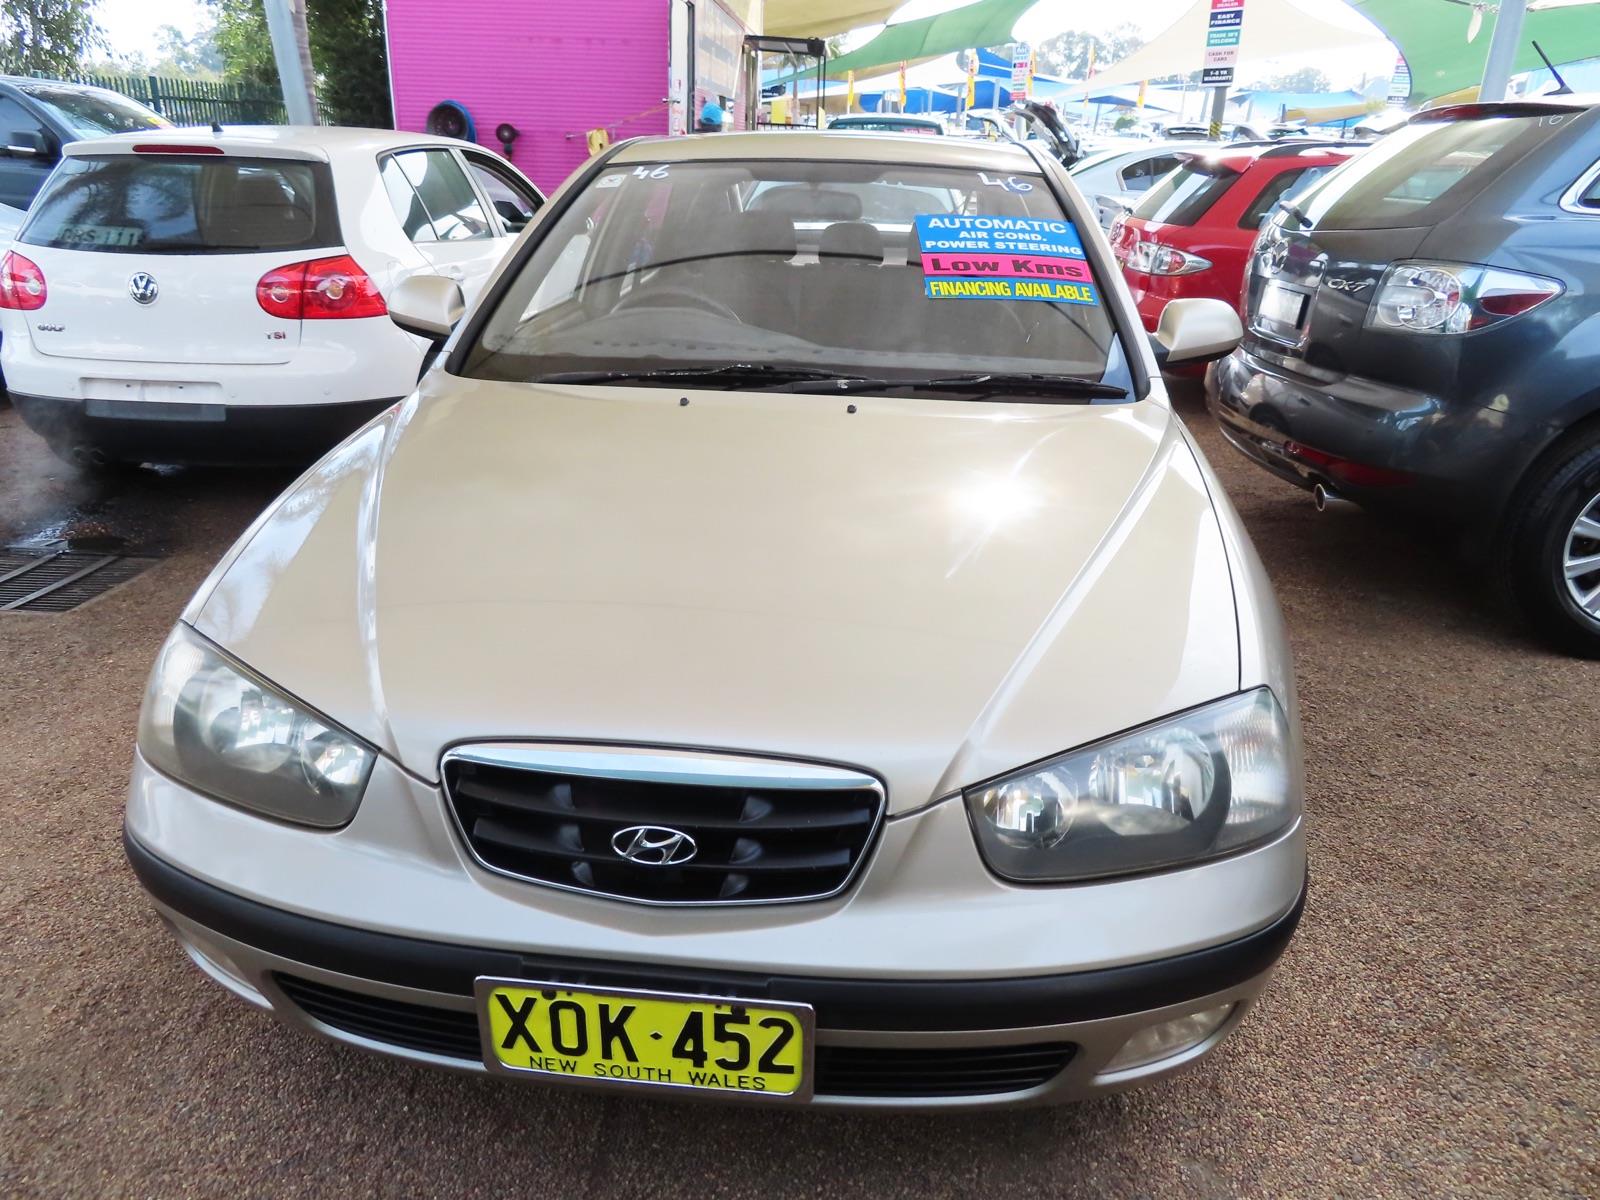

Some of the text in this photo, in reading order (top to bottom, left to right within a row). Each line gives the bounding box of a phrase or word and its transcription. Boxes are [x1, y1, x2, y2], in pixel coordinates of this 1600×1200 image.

[632, 164, 670, 180] 46
[977, 172, 1033, 192] 46
[928, 217, 1067, 234] AUTOMATIC
[958, 231, 1047, 242] AIR COND.
[925, 240, 1083, 255] POWER STEERING
[1011, 260, 1083, 278] Kms
[930, 281, 1094, 302] FINANCING AVAILABLE
[529, 1055, 766, 1090] NEW SOUTH WALES
